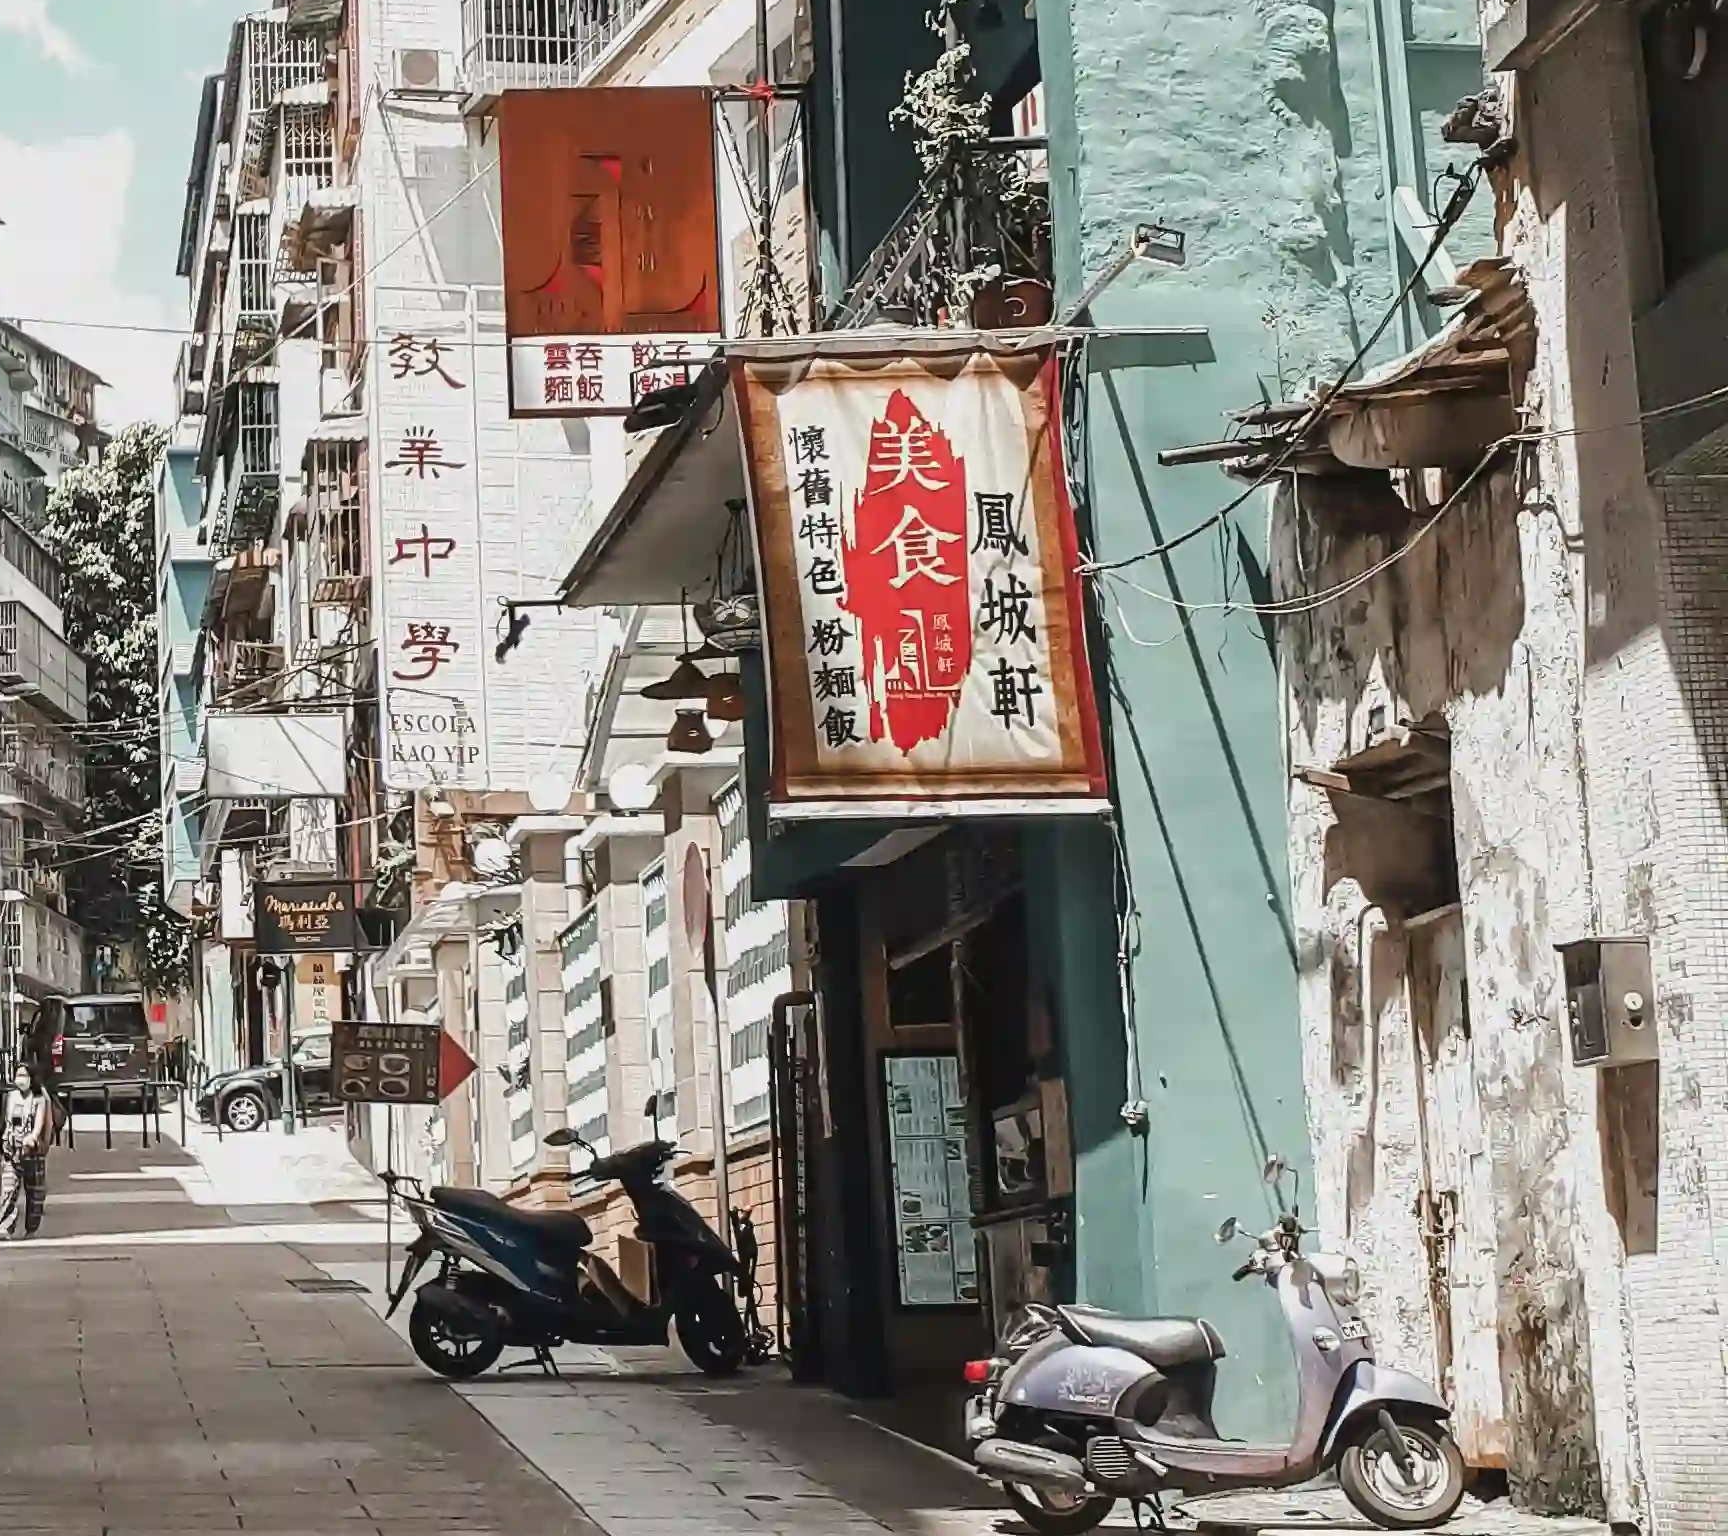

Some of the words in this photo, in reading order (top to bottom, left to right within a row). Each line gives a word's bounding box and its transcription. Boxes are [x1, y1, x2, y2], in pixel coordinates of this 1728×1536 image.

[868, 416, 964, 590] 美食
[970, 491, 1044, 730] 鳳城軒
[389, 713, 477, 733] ESCOLA
[391, 745, 435, 763] KAO
[444, 745, 480, 765] YIP
